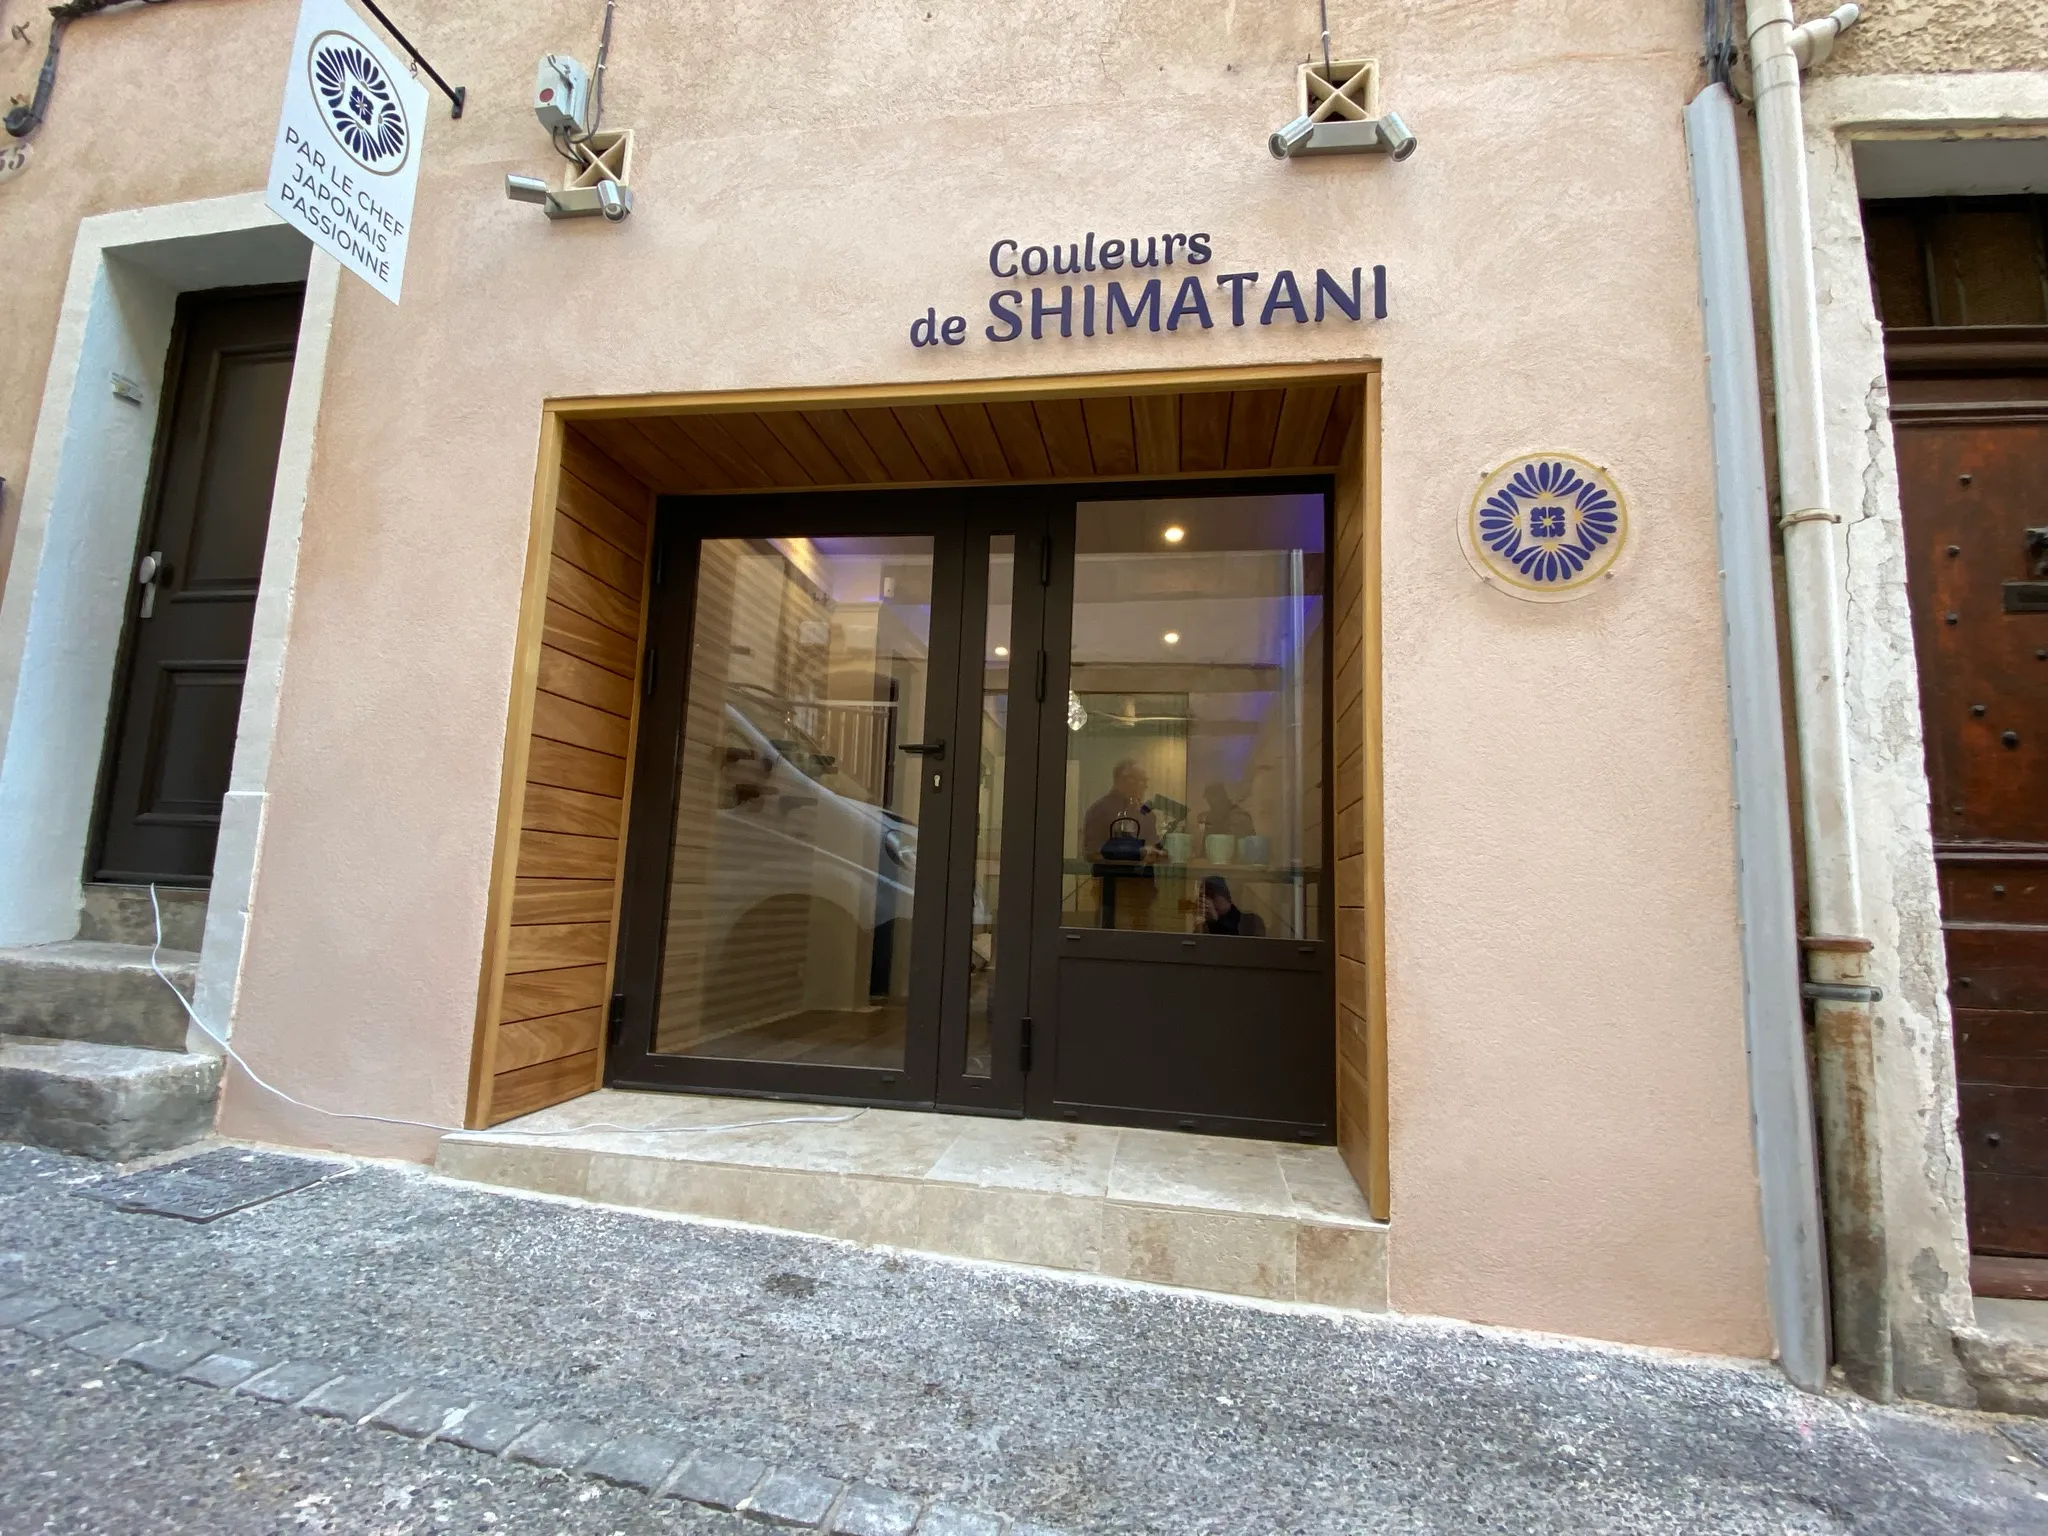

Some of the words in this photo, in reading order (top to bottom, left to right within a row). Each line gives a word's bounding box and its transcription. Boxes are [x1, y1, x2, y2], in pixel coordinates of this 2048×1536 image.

[285, 126, 326, 174] PAR
[331, 166, 354, 197] LE
[358, 191, 404, 236] CHEF
[292, 163, 387, 252] JAPONAIS
[281, 183, 390, 282] PASSIONNÉ
[989, 232, 1212, 278] Couleurs
[910, 308, 967, 347] de
[985, 265, 1387, 342] SHIMATANI
